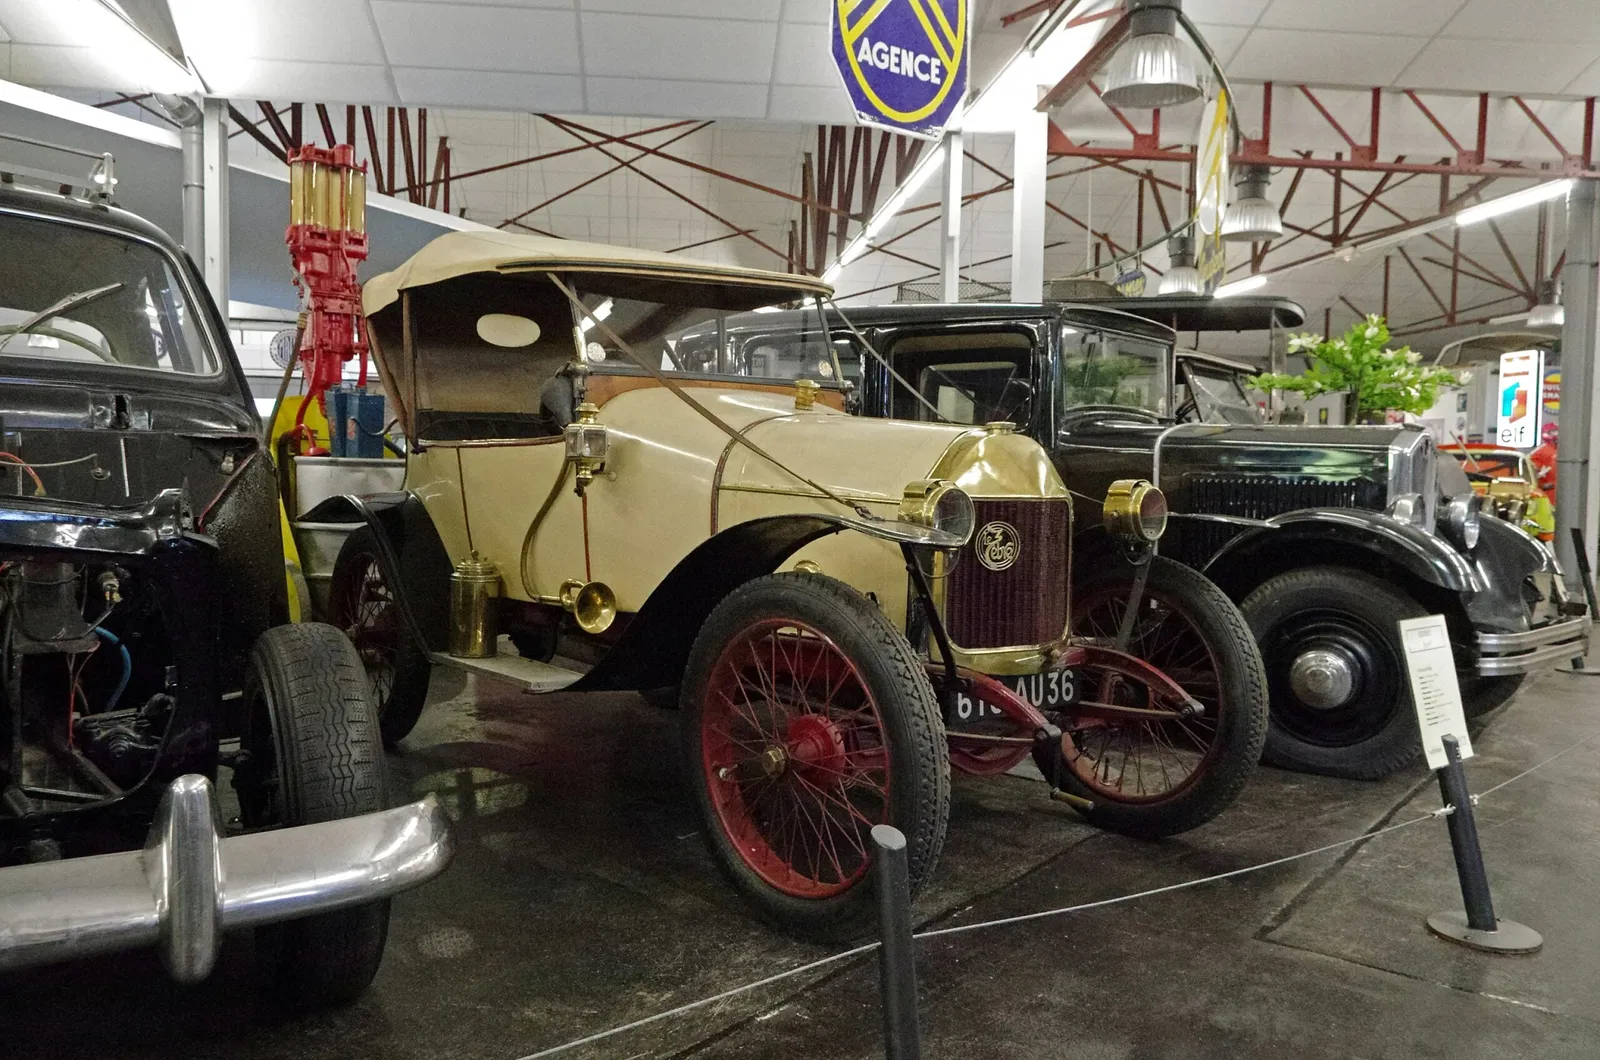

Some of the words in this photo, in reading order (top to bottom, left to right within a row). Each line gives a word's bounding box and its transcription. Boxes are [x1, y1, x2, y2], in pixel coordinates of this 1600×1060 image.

[858, 37, 941, 85] AGENCE
[1501, 426, 1525, 443] elf
[1015, 669, 1075, 708] AU36
